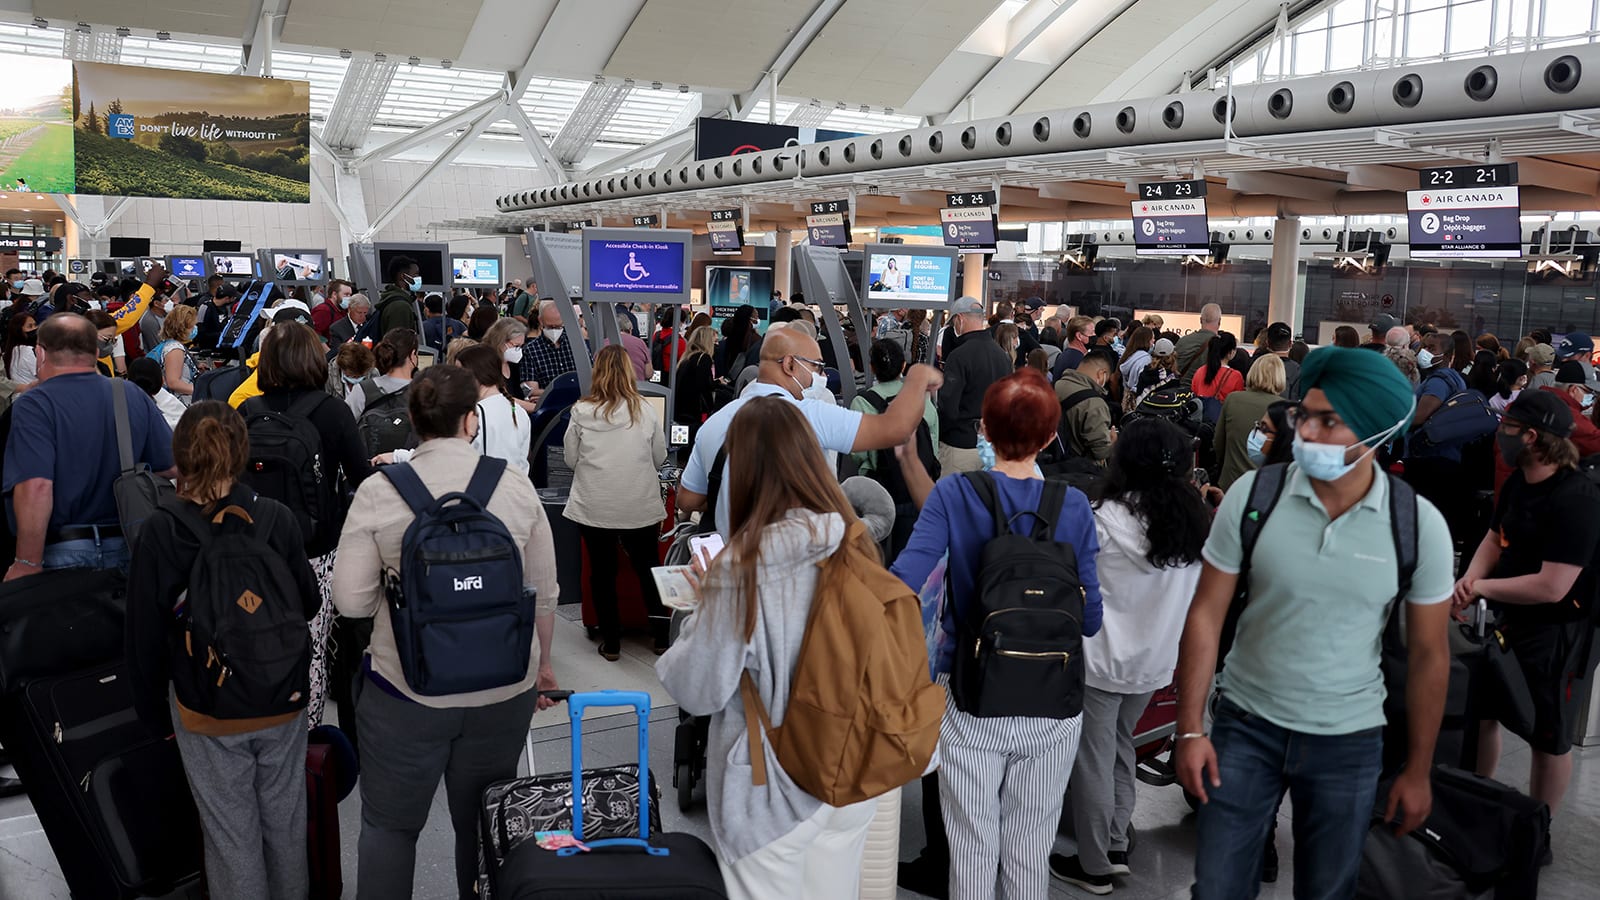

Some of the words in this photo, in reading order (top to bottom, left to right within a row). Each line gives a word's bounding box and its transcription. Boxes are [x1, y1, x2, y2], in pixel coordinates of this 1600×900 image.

[115, 118, 134, 127] AM
[117, 126, 134, 135] EX
[140, 124, 169, 133] DON'T
[171, 121, 199, 138] live
[200, 123, 224, 141] life
[225, 130, 266, 139] WITHOUT
[1430, 171, 1454, 184] 2-2
[1476, 168, 1497, 183] 2-1
[1146, 185, 1162, 196] 2-4
[1175, 183, 1191, 195] 2-3
[951, 195, 963, 205] 2-6
[971, 194, 983, 204] 2-5
[1435, 195, 1454, 203] AIR
[1456, 193, 1504, 202] CANADA
[1442, 215, 1454, 223] Bag
[1454, 214, 1471, 223] Drop
[1443, 224, 1486, 232] Dépôt-bagages
[595, 282, 614, 290] Kiosque
[453, 575, 483, 591] bird
